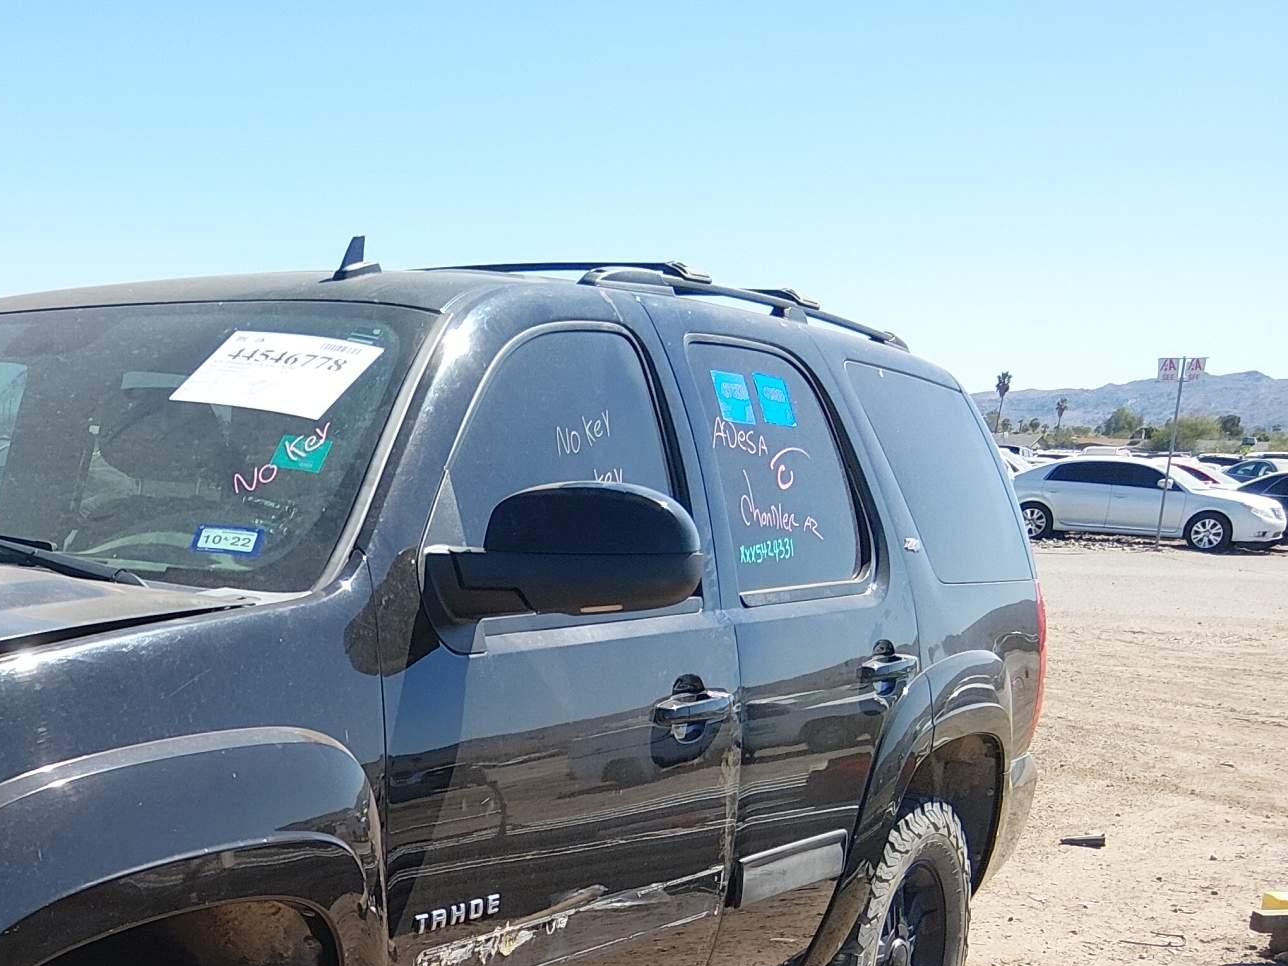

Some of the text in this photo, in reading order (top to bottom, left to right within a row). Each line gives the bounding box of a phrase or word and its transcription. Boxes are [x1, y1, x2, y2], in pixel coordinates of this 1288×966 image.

[227, 347, 348, 373] 44546778
[203, 534, 252, 548] 10 22
[414, 892, 501, 935] TAHOE
